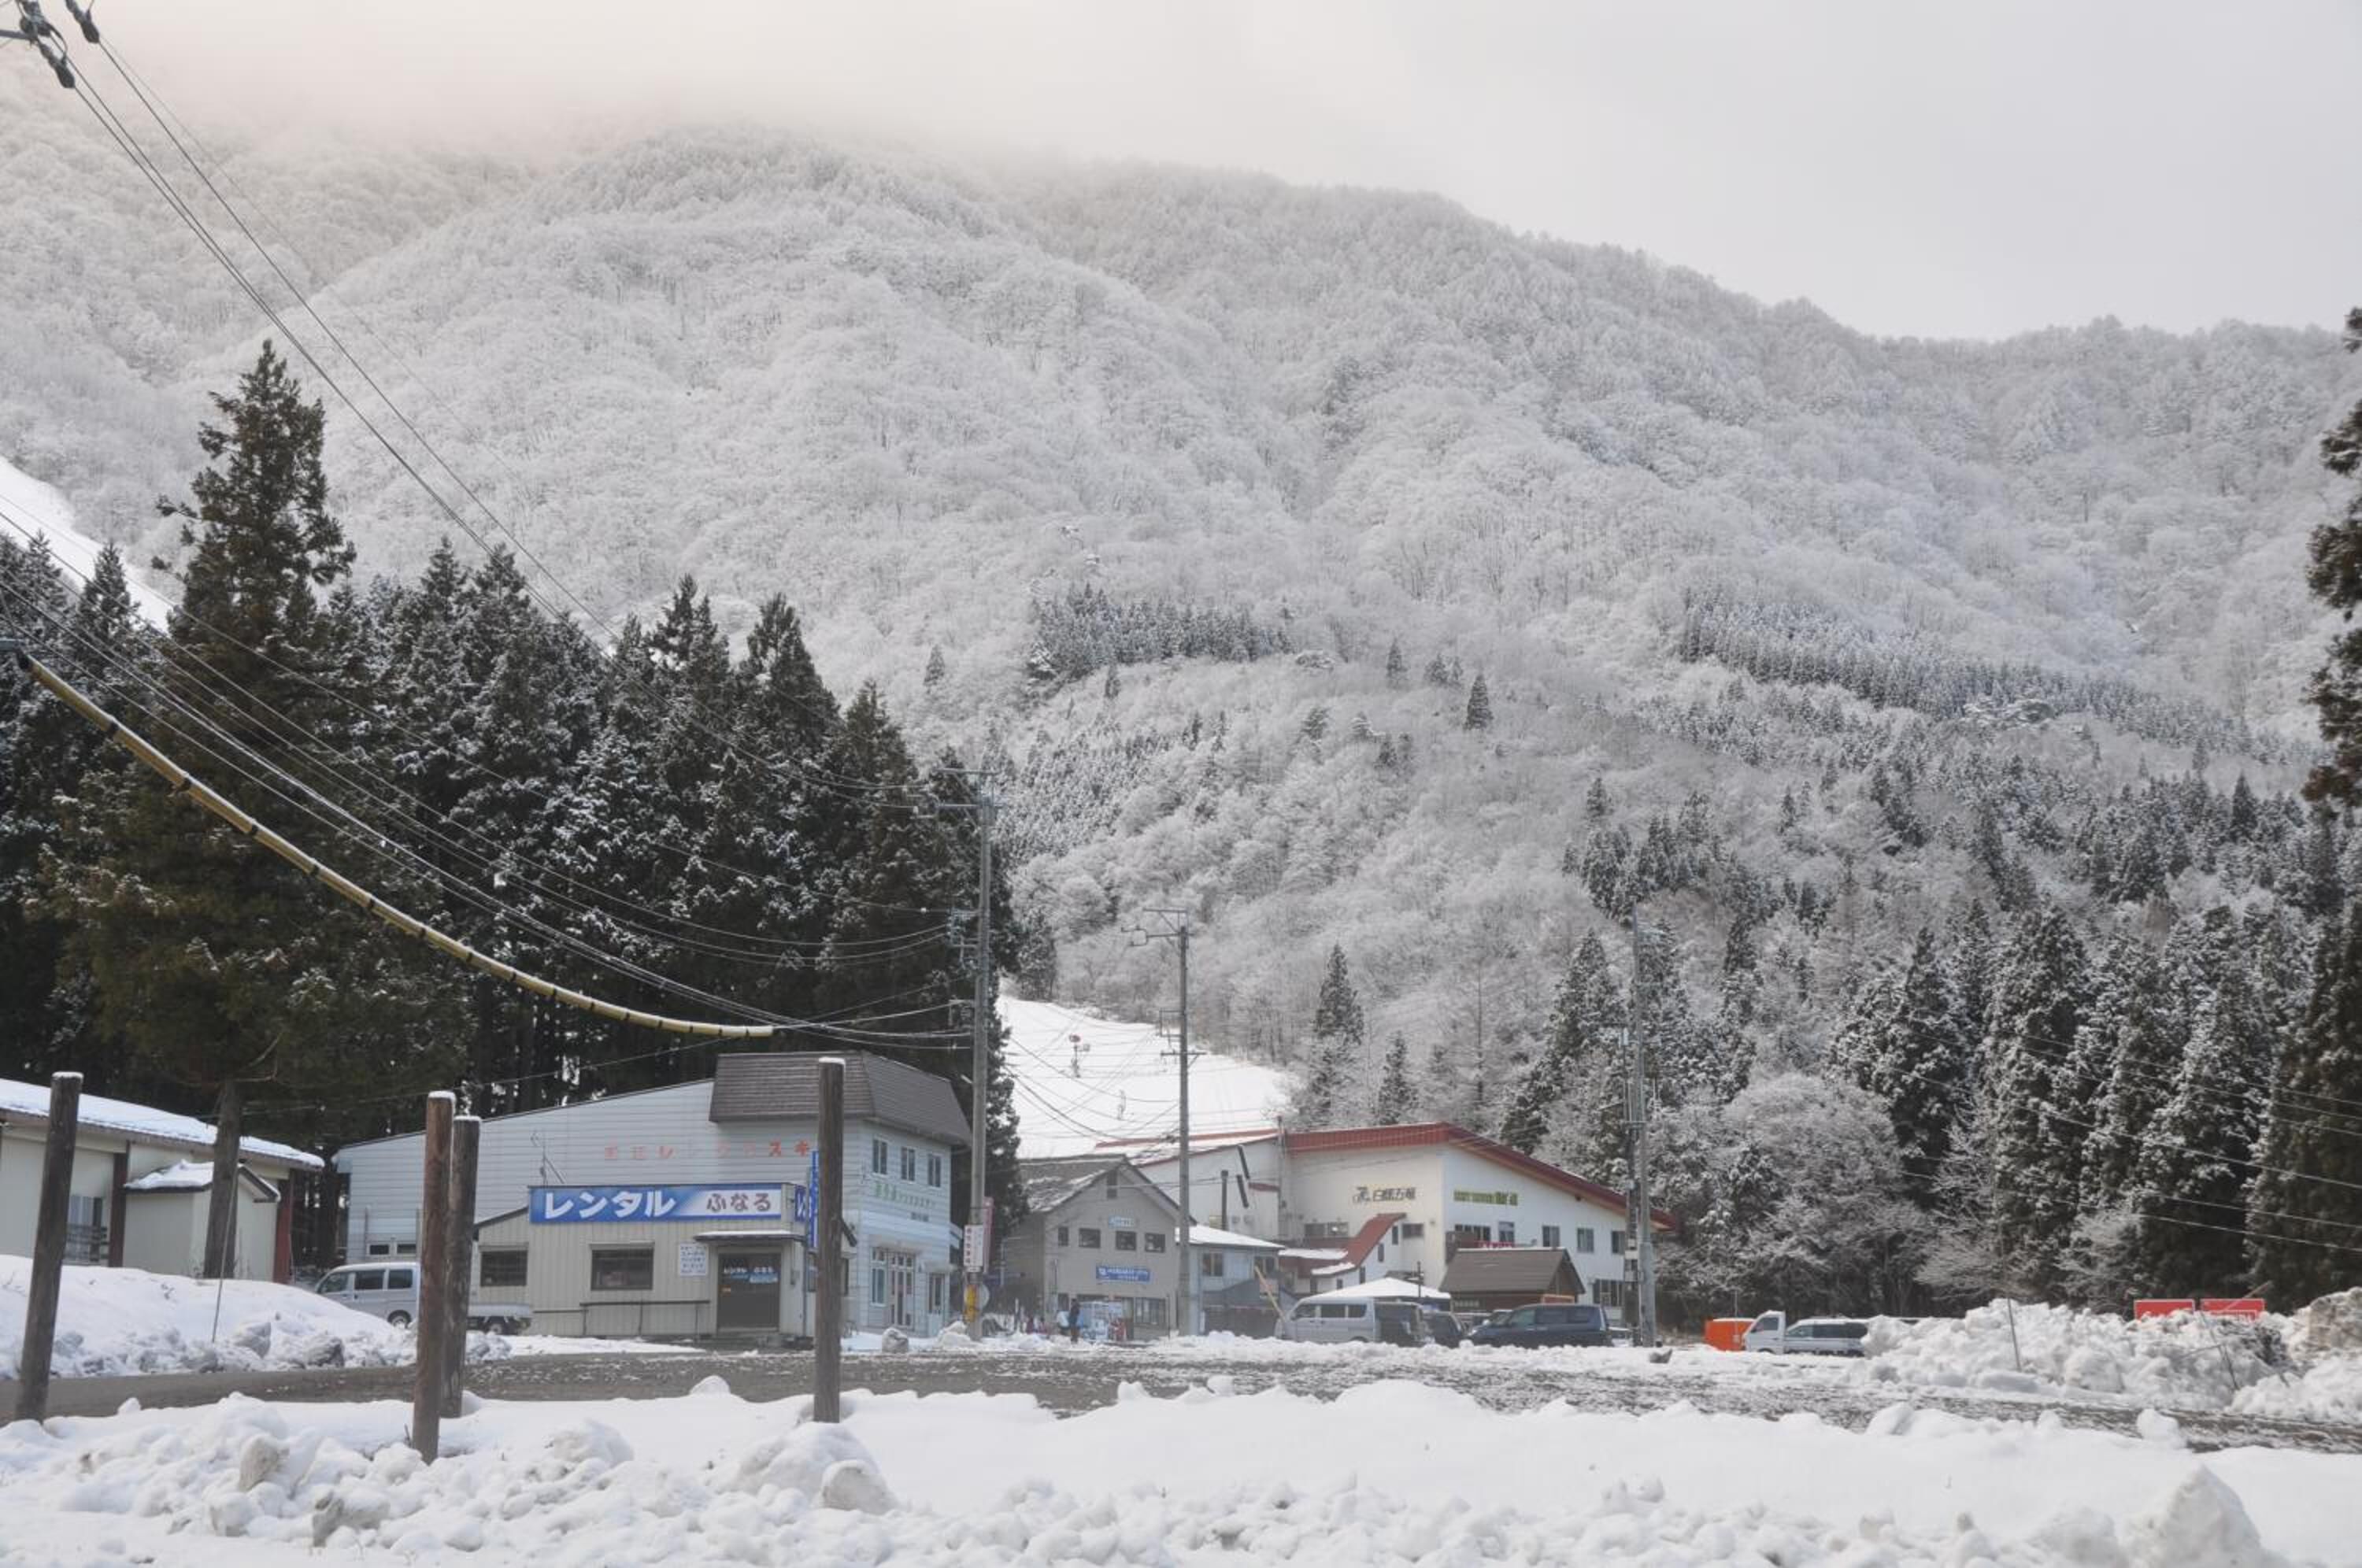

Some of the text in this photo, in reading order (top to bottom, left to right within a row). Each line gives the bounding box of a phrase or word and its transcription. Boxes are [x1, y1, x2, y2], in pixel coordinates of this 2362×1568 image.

[545, 1190, 676, 1219] レンタル
[706, 1193, 772, 1212] ふなる
